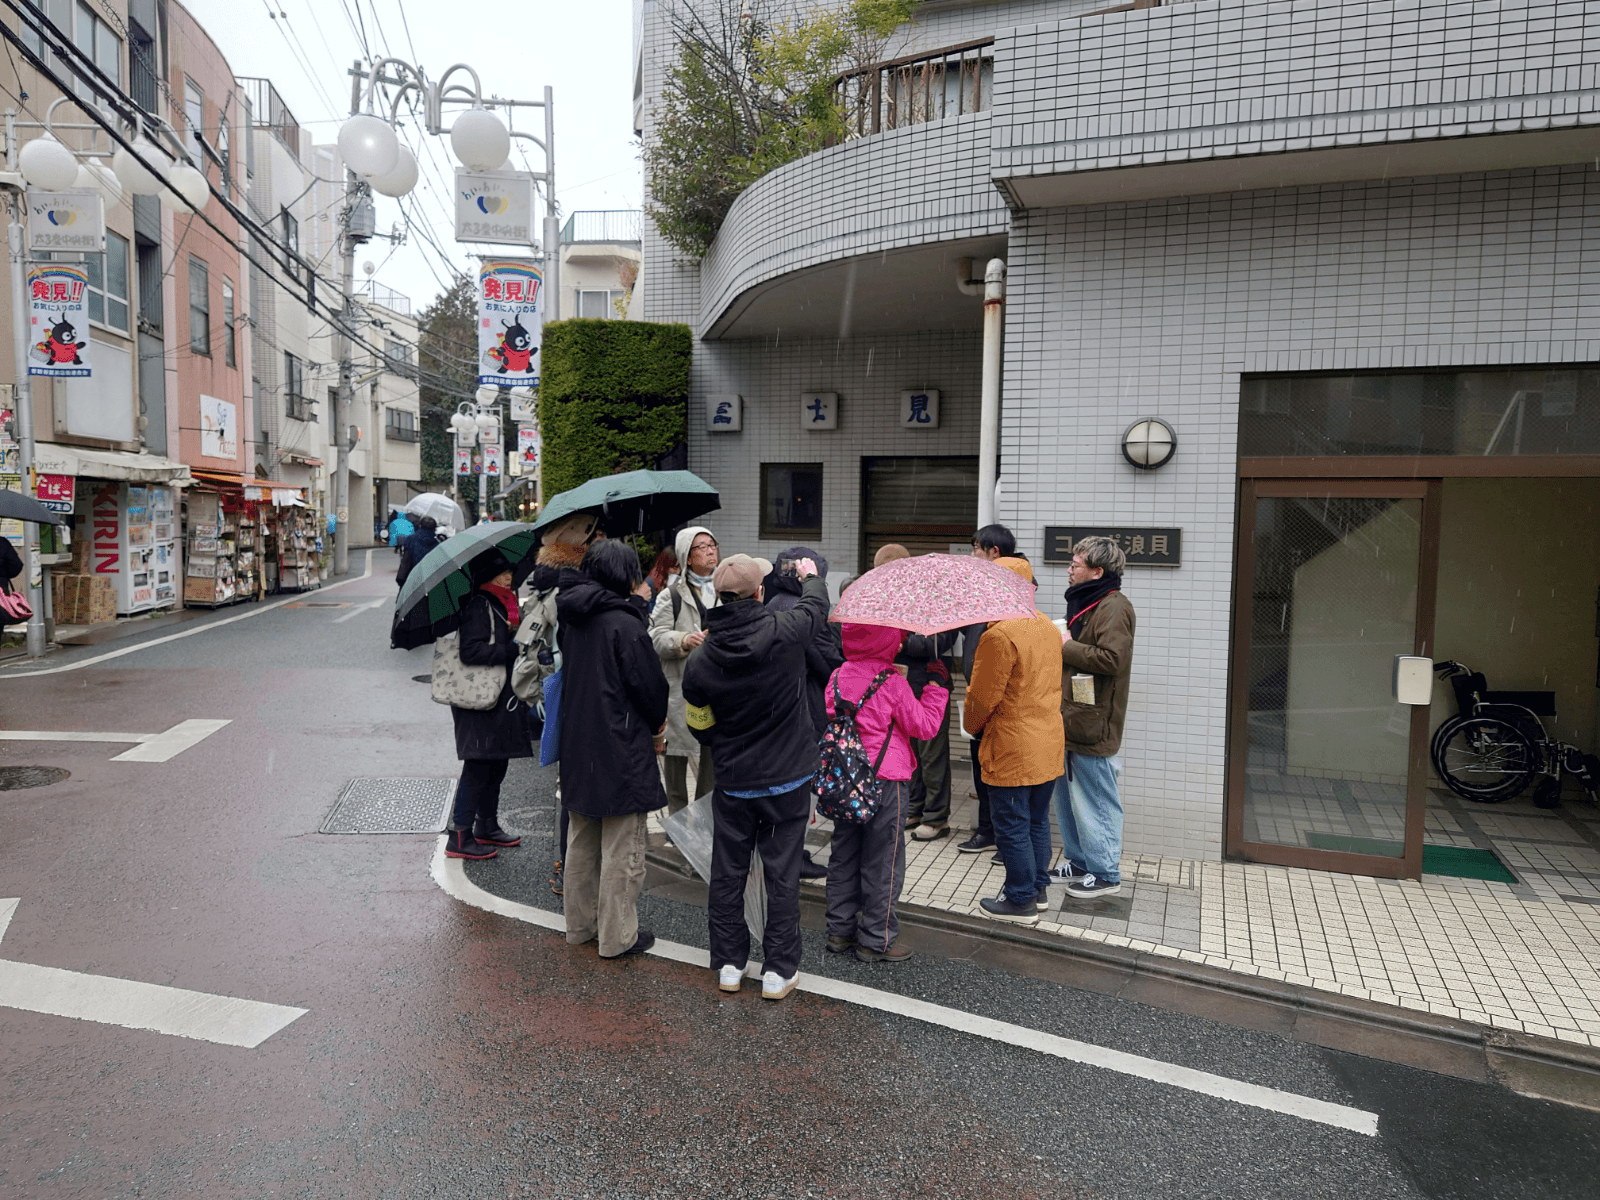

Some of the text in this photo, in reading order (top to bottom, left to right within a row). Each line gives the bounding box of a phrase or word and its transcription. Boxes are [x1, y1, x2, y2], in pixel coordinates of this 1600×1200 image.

[33, 302, 82, 311] お気に入りの店
[485, 303, 537, 313] お気に入りの店
[36, 475, 71, 501] たばこ
[92, 482, 120, 574] KIRIN
[134, 588, 151, 603] KIRIN
[687, 710, 708, 722] PRESS
